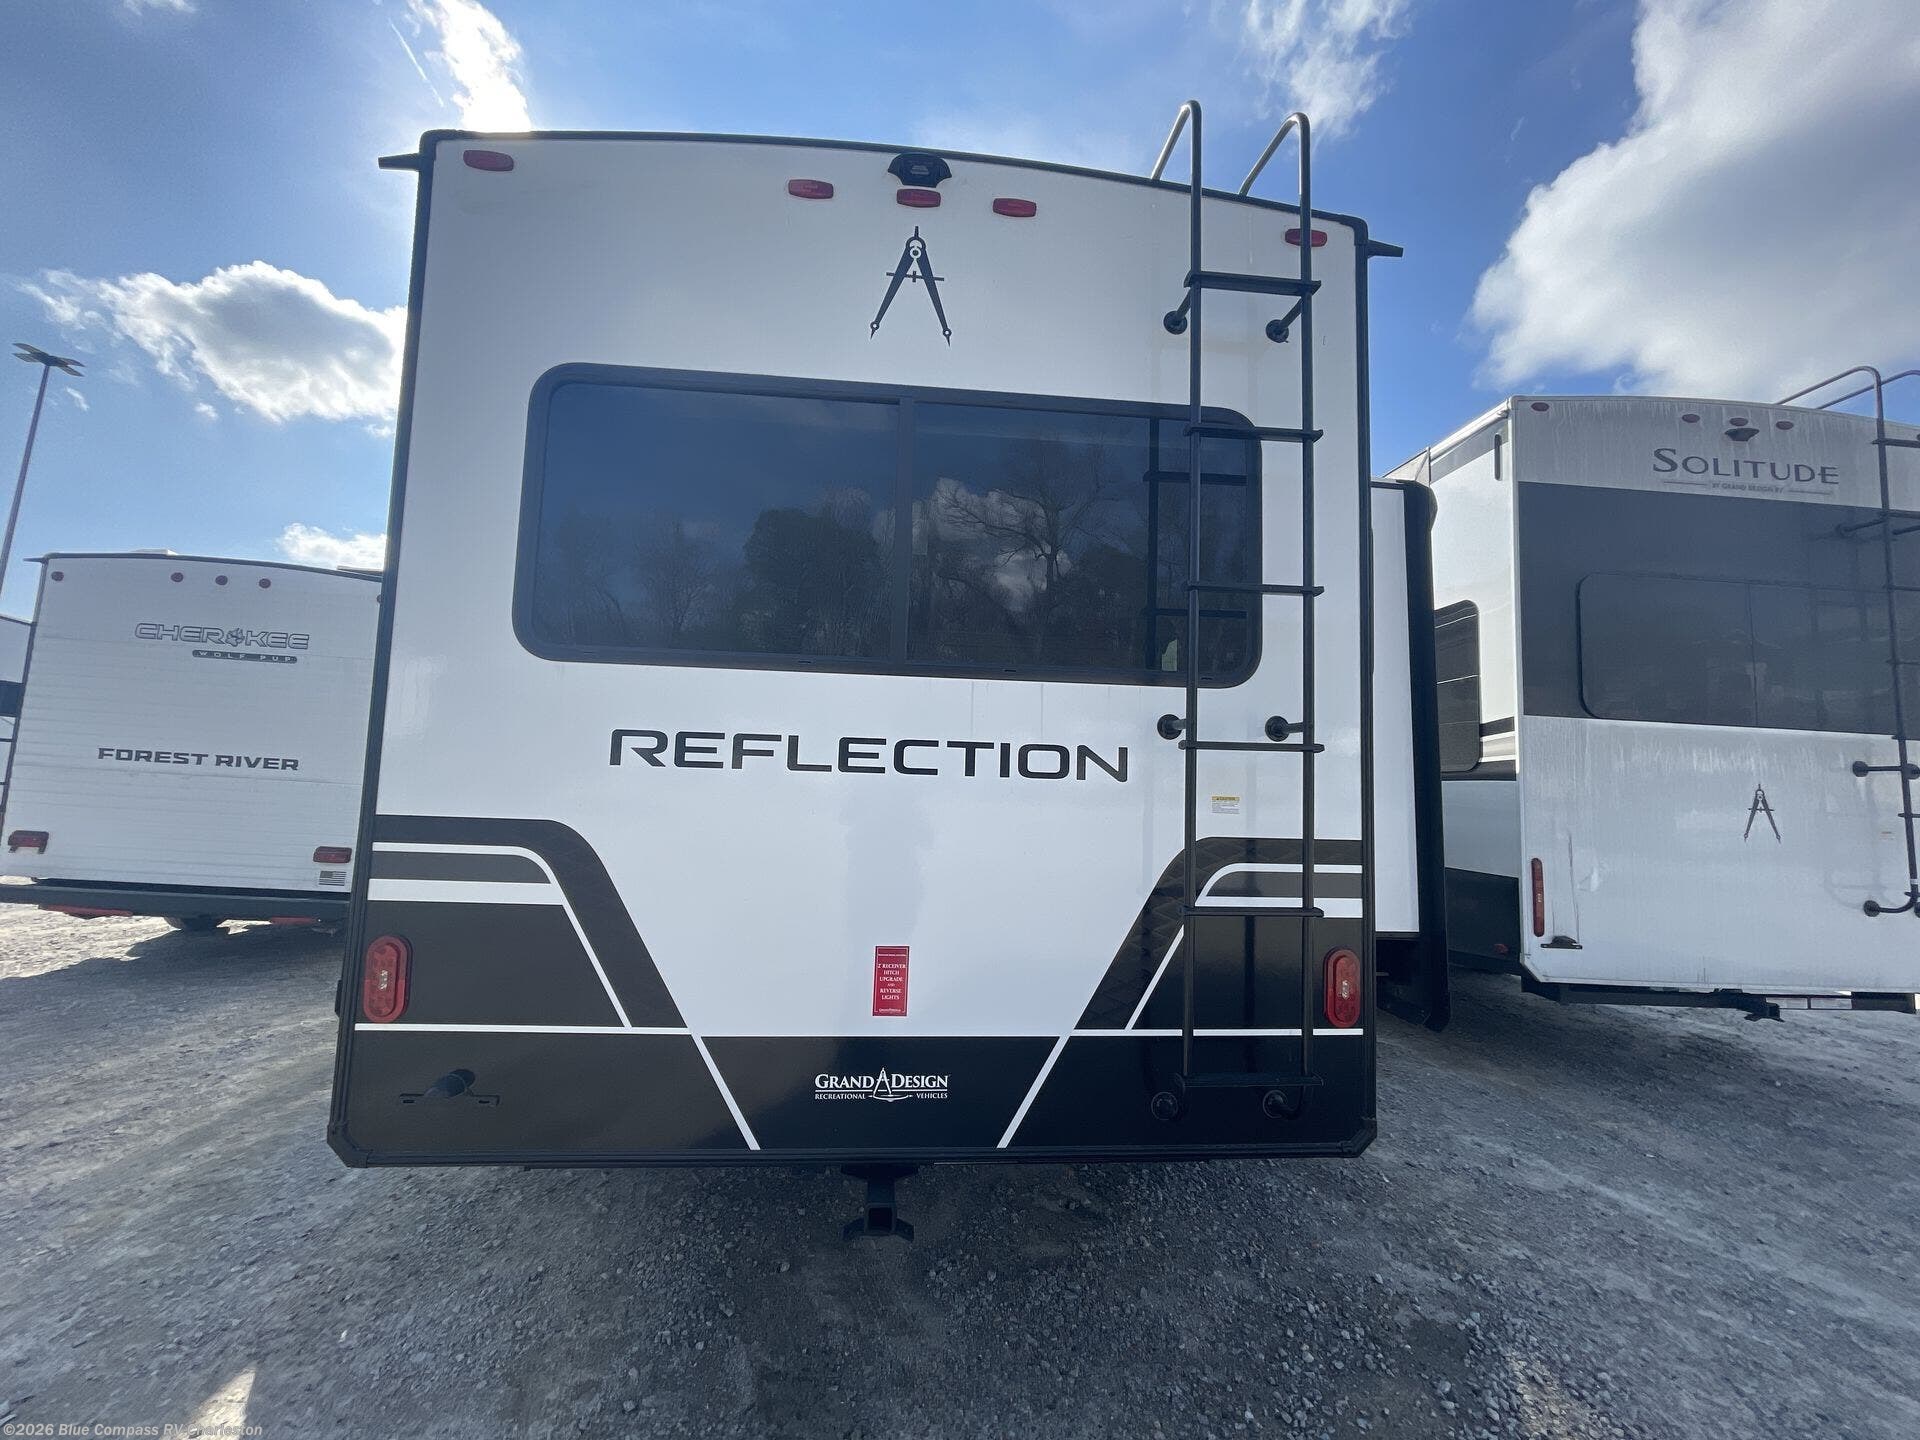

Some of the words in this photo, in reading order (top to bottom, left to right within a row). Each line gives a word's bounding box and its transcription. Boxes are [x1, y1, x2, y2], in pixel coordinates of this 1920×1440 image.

[1653, 448, 1839, 485] SOLITUDE
[135, 622, 310, 650] CHEROKEE
[199, 651, 246, 660] WOLF
[98, 747, 209, 766] FOREST
[215, 754, 300, 771] RIVER
[609, 728, 1129, 782] REFLECTION
[815, 1073, 875, 1089] GRAND
[891, 1073, 949, 1089] DESIGN
[814, 1092, 866, 1100] RECREATIONAL
